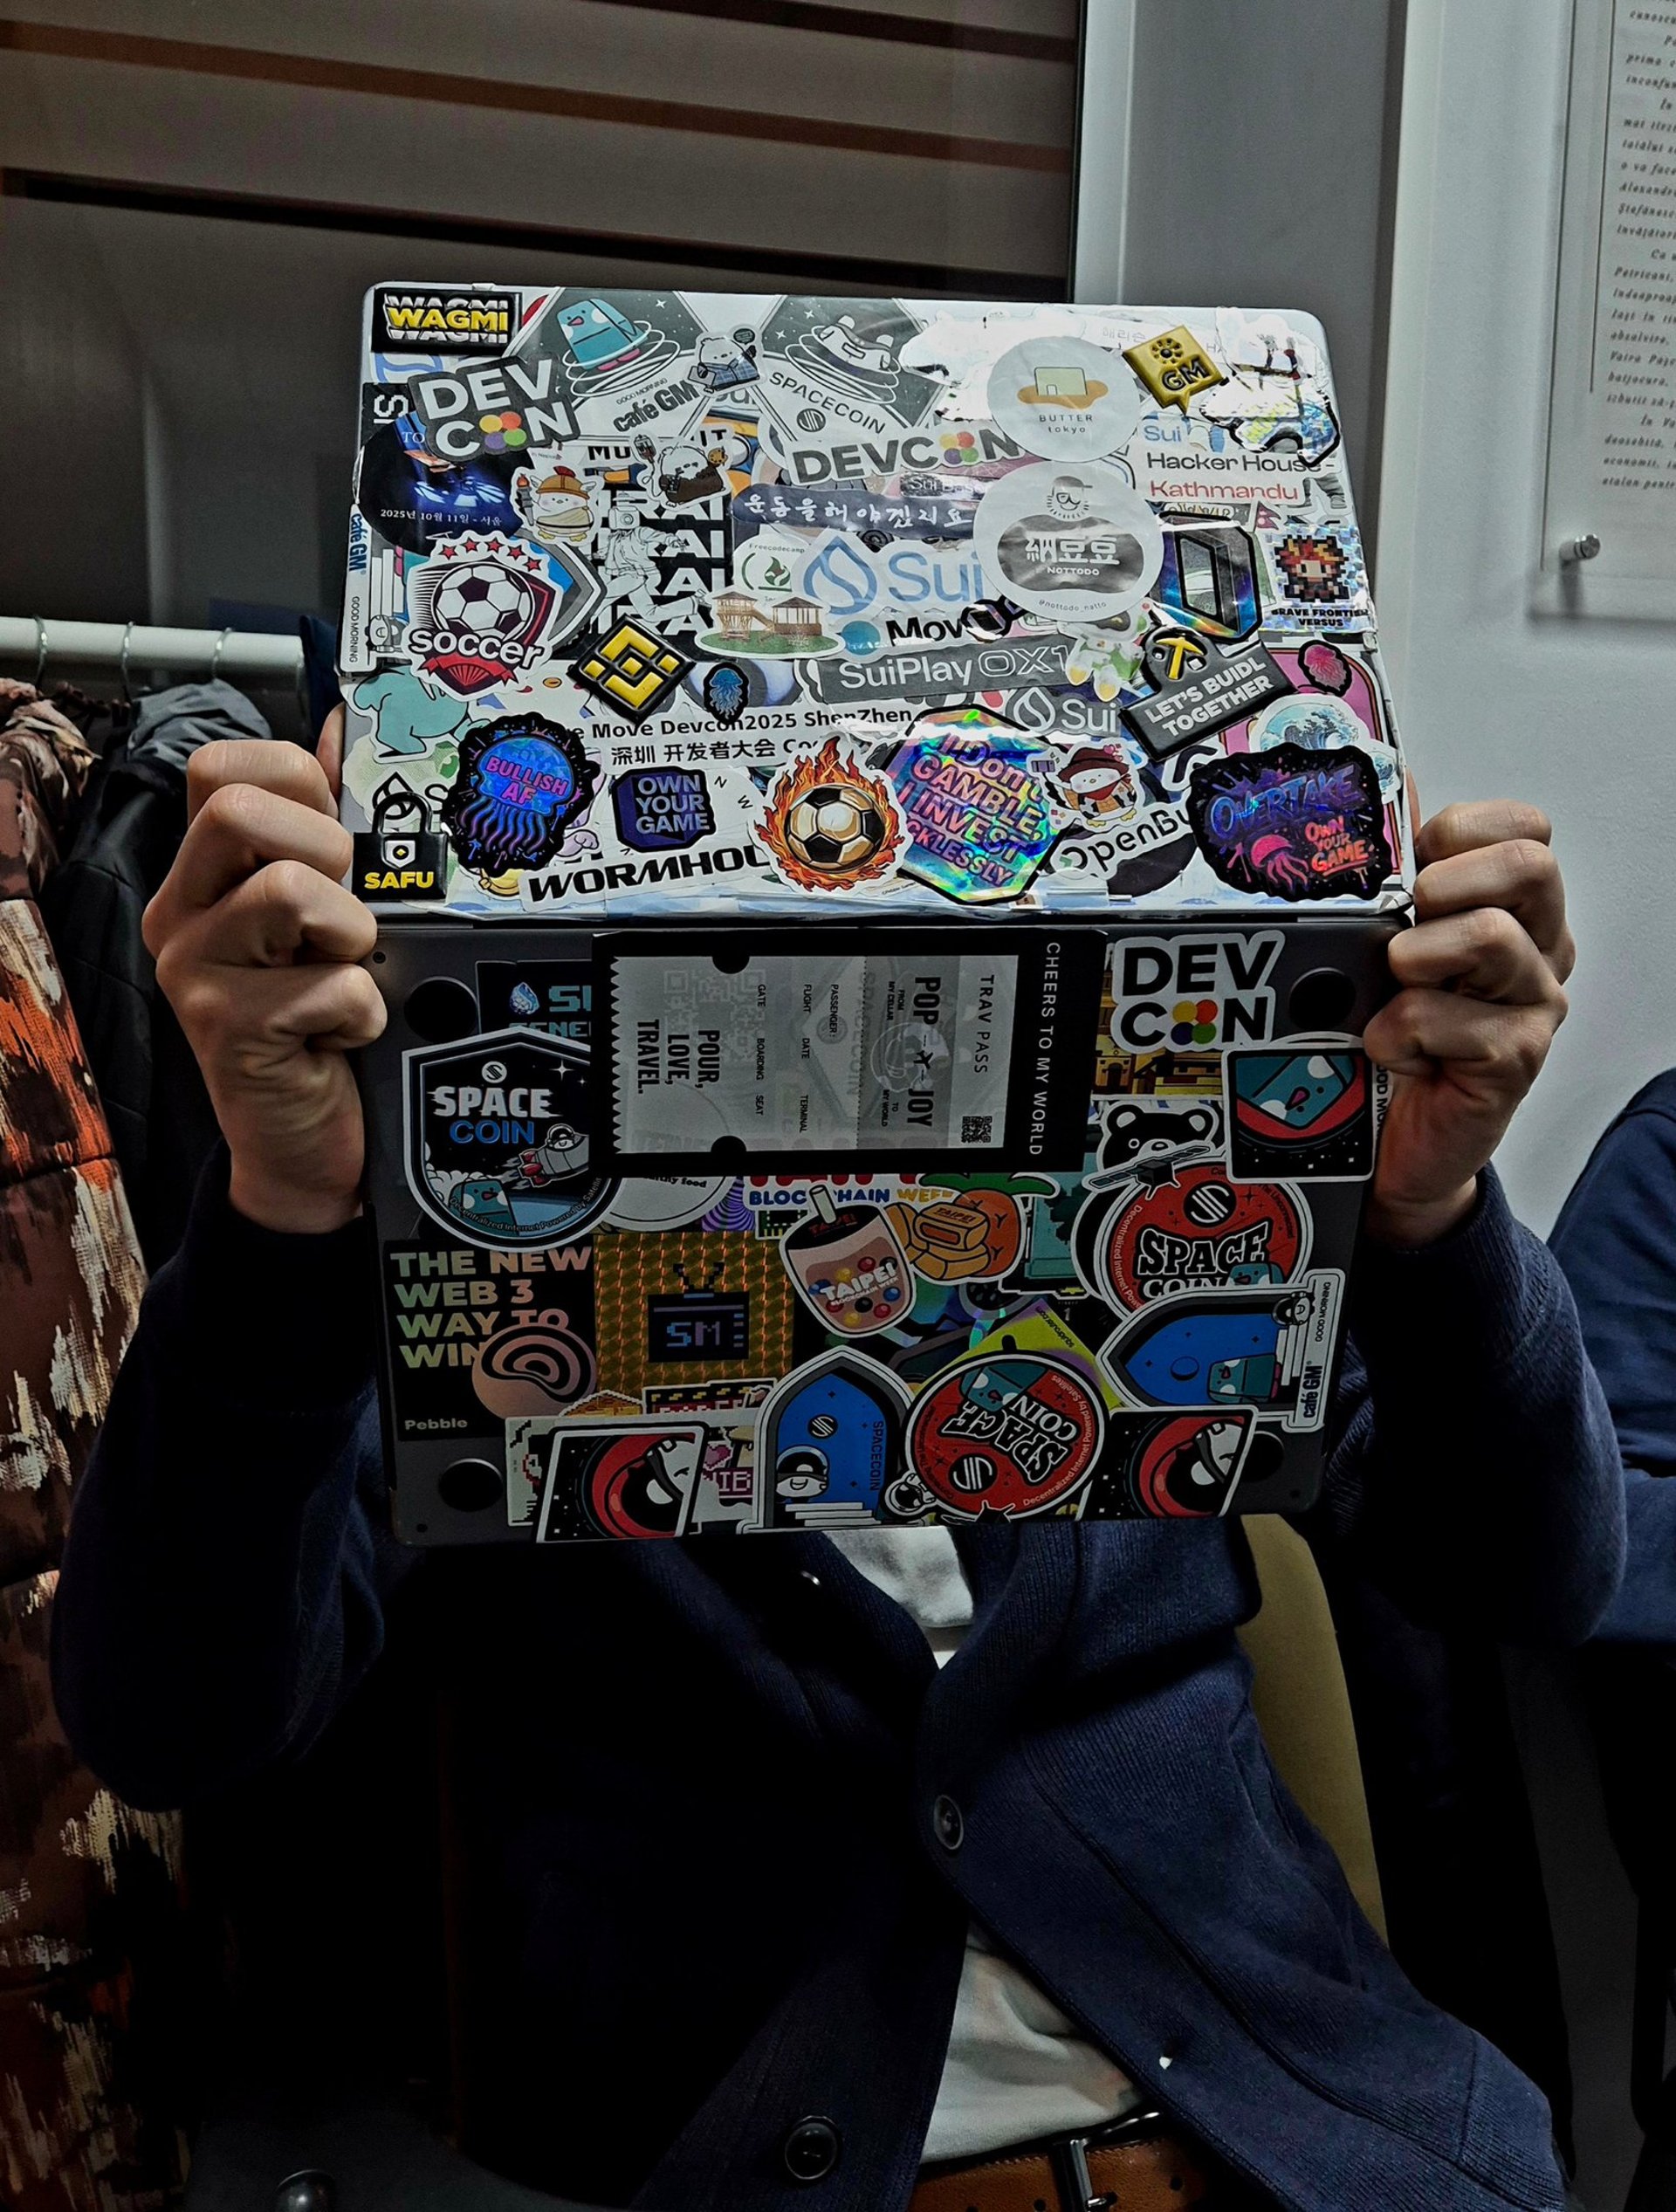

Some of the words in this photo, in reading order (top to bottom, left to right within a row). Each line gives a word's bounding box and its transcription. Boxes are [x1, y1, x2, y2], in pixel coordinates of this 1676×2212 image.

[388, 306, 508, 332] WAGMI
[418, 359, 553, 420] DEV
[1161, 358, 1210, 392] GM
[654, 379, 700, 412] GM
[769, 372, 886, 435] SPACECOIN
[1039, 414, 1094, 423] BUTTER
[1048, 425, 1086, 435] tokyo
[1144, 424, 1182, 443] Sui
[1147, 452, 1238, 471] Hacker
[1151, 480, 1299, 501] Kathmandu
[349, 542, 367, 572] GM
[1048, 567, 1100, 576] NOTTODO
[889, 550, 984, 602] Sui
[351, 595, 361, 622] GOOD
[1272, 608, 1309, 617] BRAVE
[1298, 617, 1344, 628] VERSUS
[349, 622, 361, 663] MORNING
[1201, 655, 1267, 695] BUIDL
[1061, 698, 1116, 733] Sui
[1161, 673, 1274, 737] TOGETHER
[592, 723, 654, 739] Move
[611, 746, 656, 766] 深圳
[663, 738, 776, 763] 开发者大会
[484, 755, 569, 796] BULLISH
[637, 774, 702, 794] OWN
[501, 782, 538, 805] AF
[635, 793, 705, 815] YOUR
[635, 813, 711, 835] GAME
[912, 787, 1029, 862] INVEST
[1311, 839, 1370, 872] GAME
[363, 870, 435, 890] SAFU
[1041, 942, 1061, 1018] CHEERS
[1122, 940, 1278, 997] DEV
[756, 984, 767, 1008] GATE
[802, 984, 813, 1013] FLIGHT
[887, 980, 895, 994] MY
[913, 976, 942, 1026] POP
[979, 974, 995, 1024] TRAV
[886, 993, 895, 1021] CELLAR
[800, 1037, 810, 1060] DATE
[973, 1030, 991, 1074] PASS
[1038, 1025, 1053, 1050] TO
[637, 1019, 660, 1095] TRAVEL.
[664, 1034, 690, 1085] LOVE,
[695, 1029, 721, 1089] POUR,
[755, 1037, 766, 1081] BOARDING
[1034, 1056, 1051, 1083] MY
[429, 1085, 560, 1118] SPACE
[754, 1095, 765, 1116] SEAT
[799, 1095, 808, 1133] TERMINAL
[880, 1100, 890, 1127] WORLD
[907, 1088, 934, 1128] JOY
[449, 1119, 536, 1145] COIN
[1028, 1091, 1048, 1156] WORLD
[683, 1177, 708, 1188] food
[932, 1206, 977, 1224] TAIPEI
[390, 1249, 477, 1277] THE
[490, 1246, 592, 1274] NEW
[1137, 1220, 1269, 1276] SPACE
[394, 1281, 498, 1309] WEB
[510, 1279, 534, 1304] 3
[820, 1261, 897, 1302] TAIPEI
[1317, 1281, 1332, 1319] MORNING
[396, 1310, 501, 1339] WAY
[1315, 1319, 1326, 1343] GOOD
[1302, 1364, 1322, 1391] GM
[1009, 1394, 1077, 1443] COIN
[1300, 1391, 1319, 1419] café
[404, 1417, 469, 1432] Pebble
[869, 1419, 884, 1492] SPACECOIN
[940, 1400, 1068, 1483] SPACE
